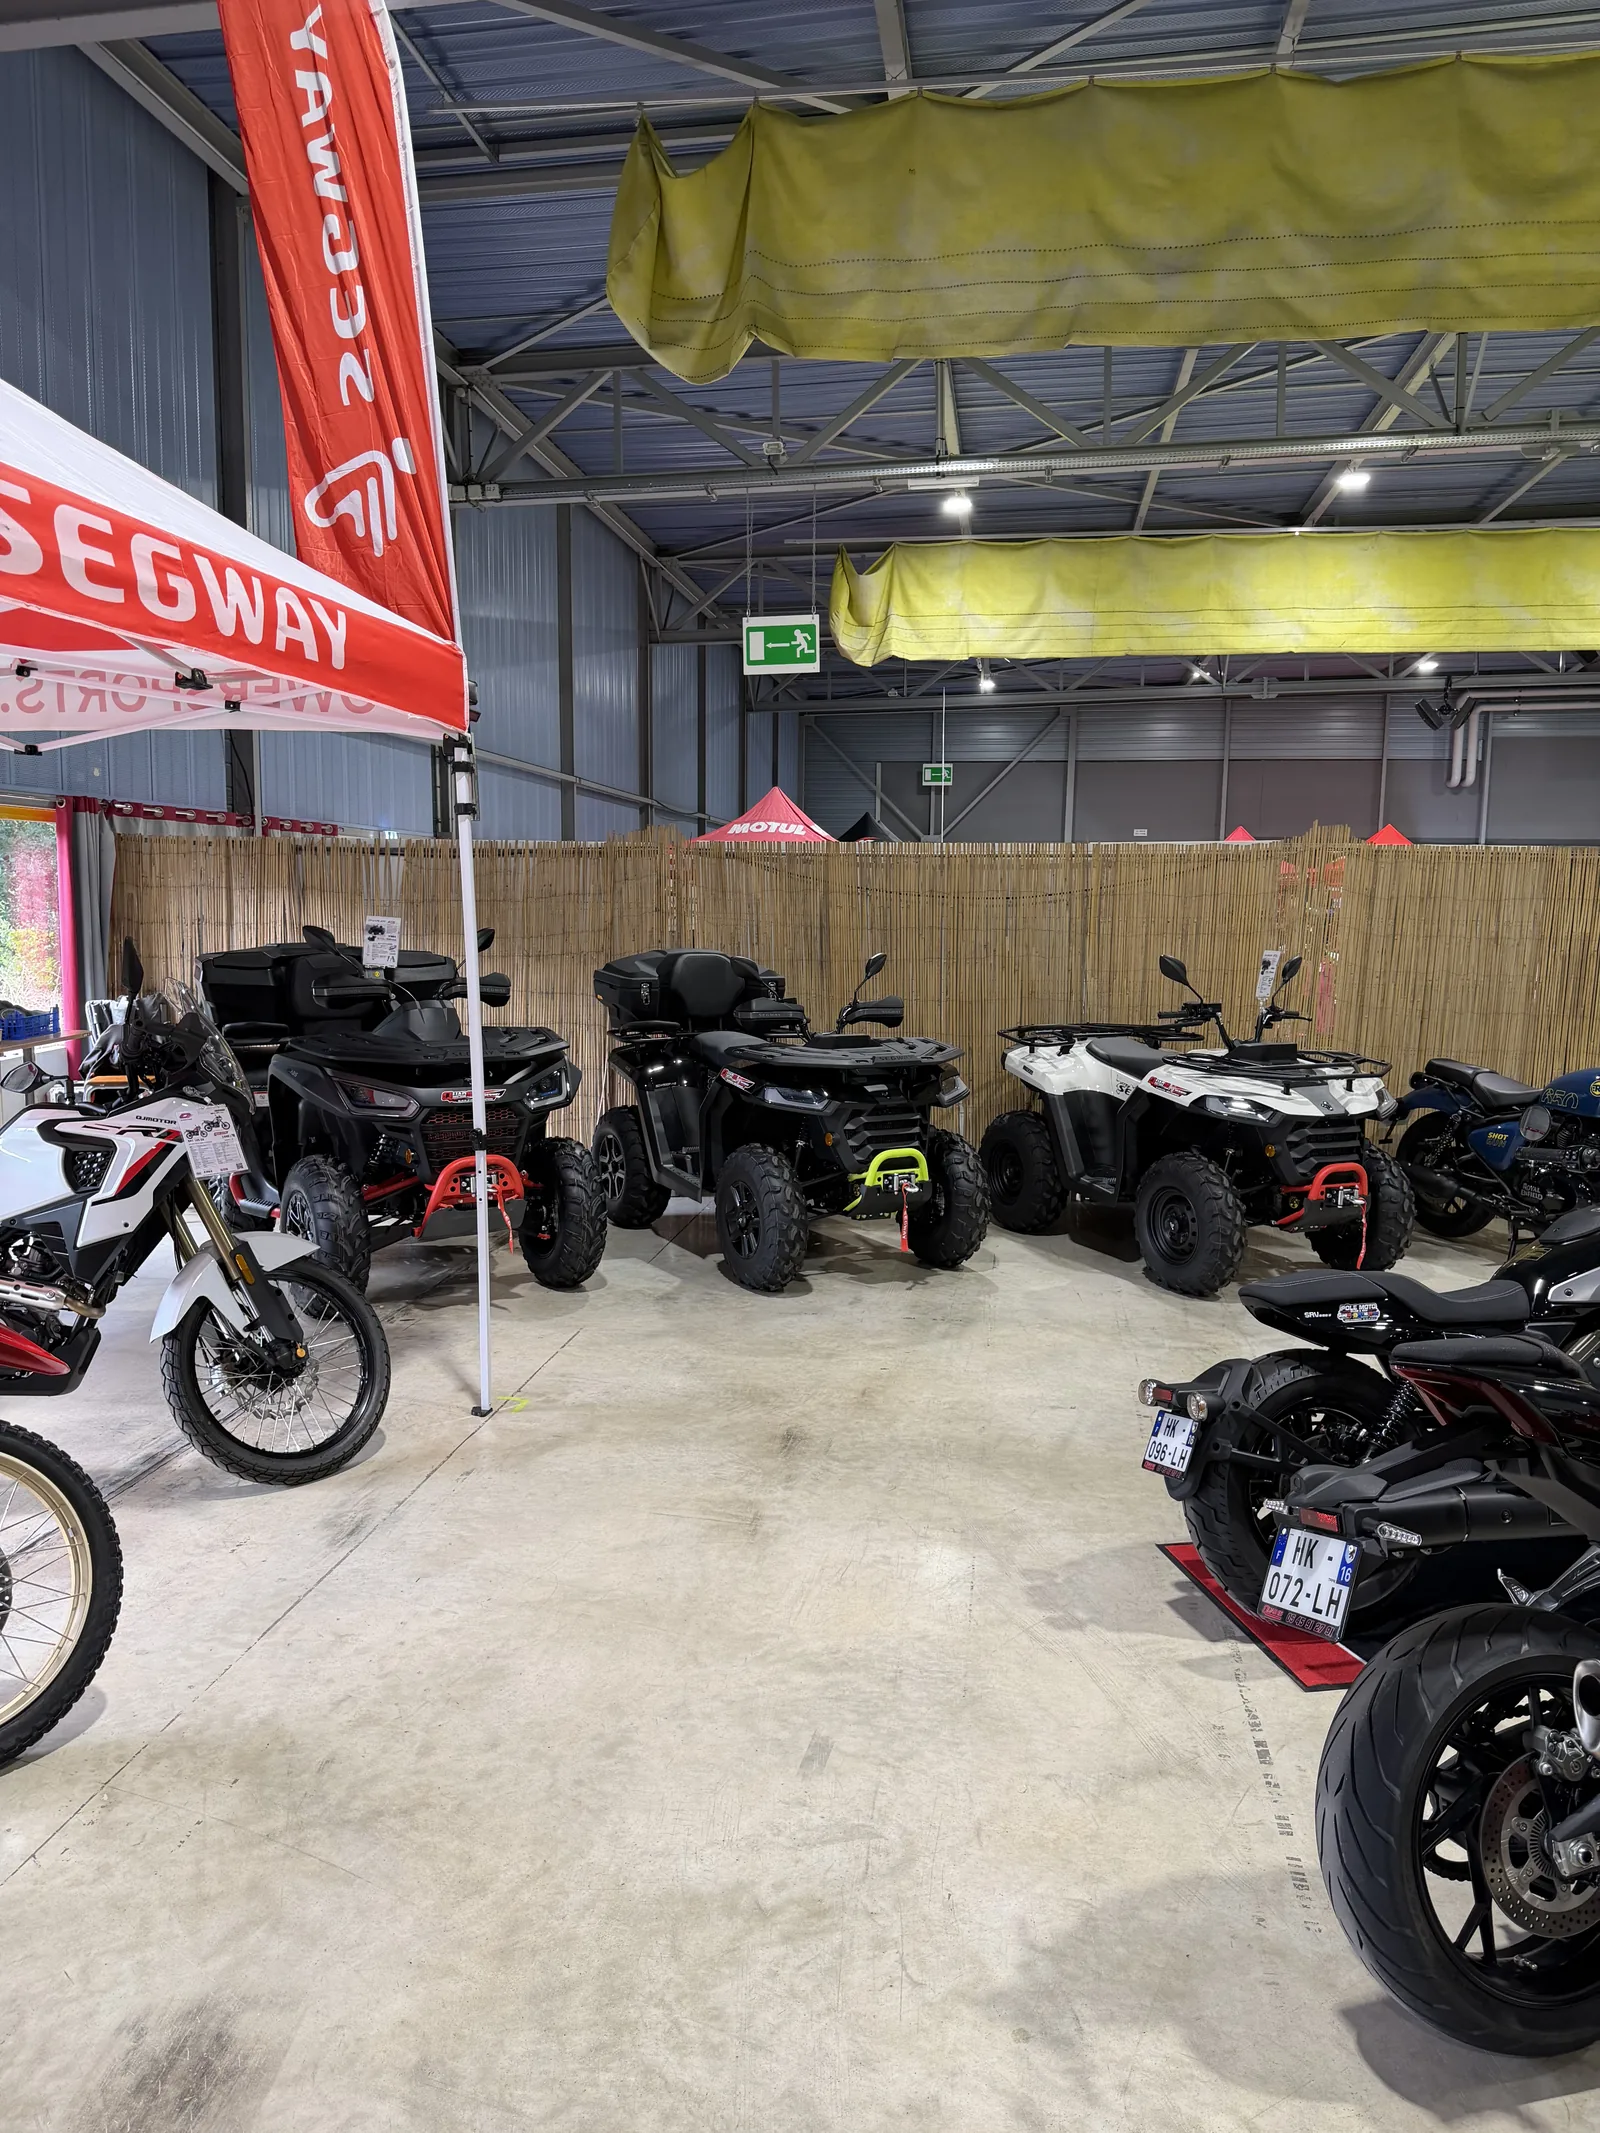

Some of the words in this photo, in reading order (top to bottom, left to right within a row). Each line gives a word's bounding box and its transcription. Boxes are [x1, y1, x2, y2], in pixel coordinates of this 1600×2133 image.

[0, 479, 347, 670] SEGWAY
[727, 821, 807, 836] MOTUL
[135, 1115, 177, 1125] QJMOTOR
[1487, 1132, 1509, 1141] SHOT
[1522, 1182, 1541, 1194] ROYAL
[1163, 1417, 1180, 1439] HK
[1148, 1440, 1188, 1469] 096-LH
[1292, 1536, 1319, 1569] HK
[1340, 1566, 1353, 1583] 16
[1268, 1571, 1343, 1620] 072-LH
[1295, 1615, 1306, 1627] 45
[1305, 1618, 1315, 1630] 91
[1314, 1622, 1326, 1634] 27
[1324, 1626, 1336, 1637] 91
